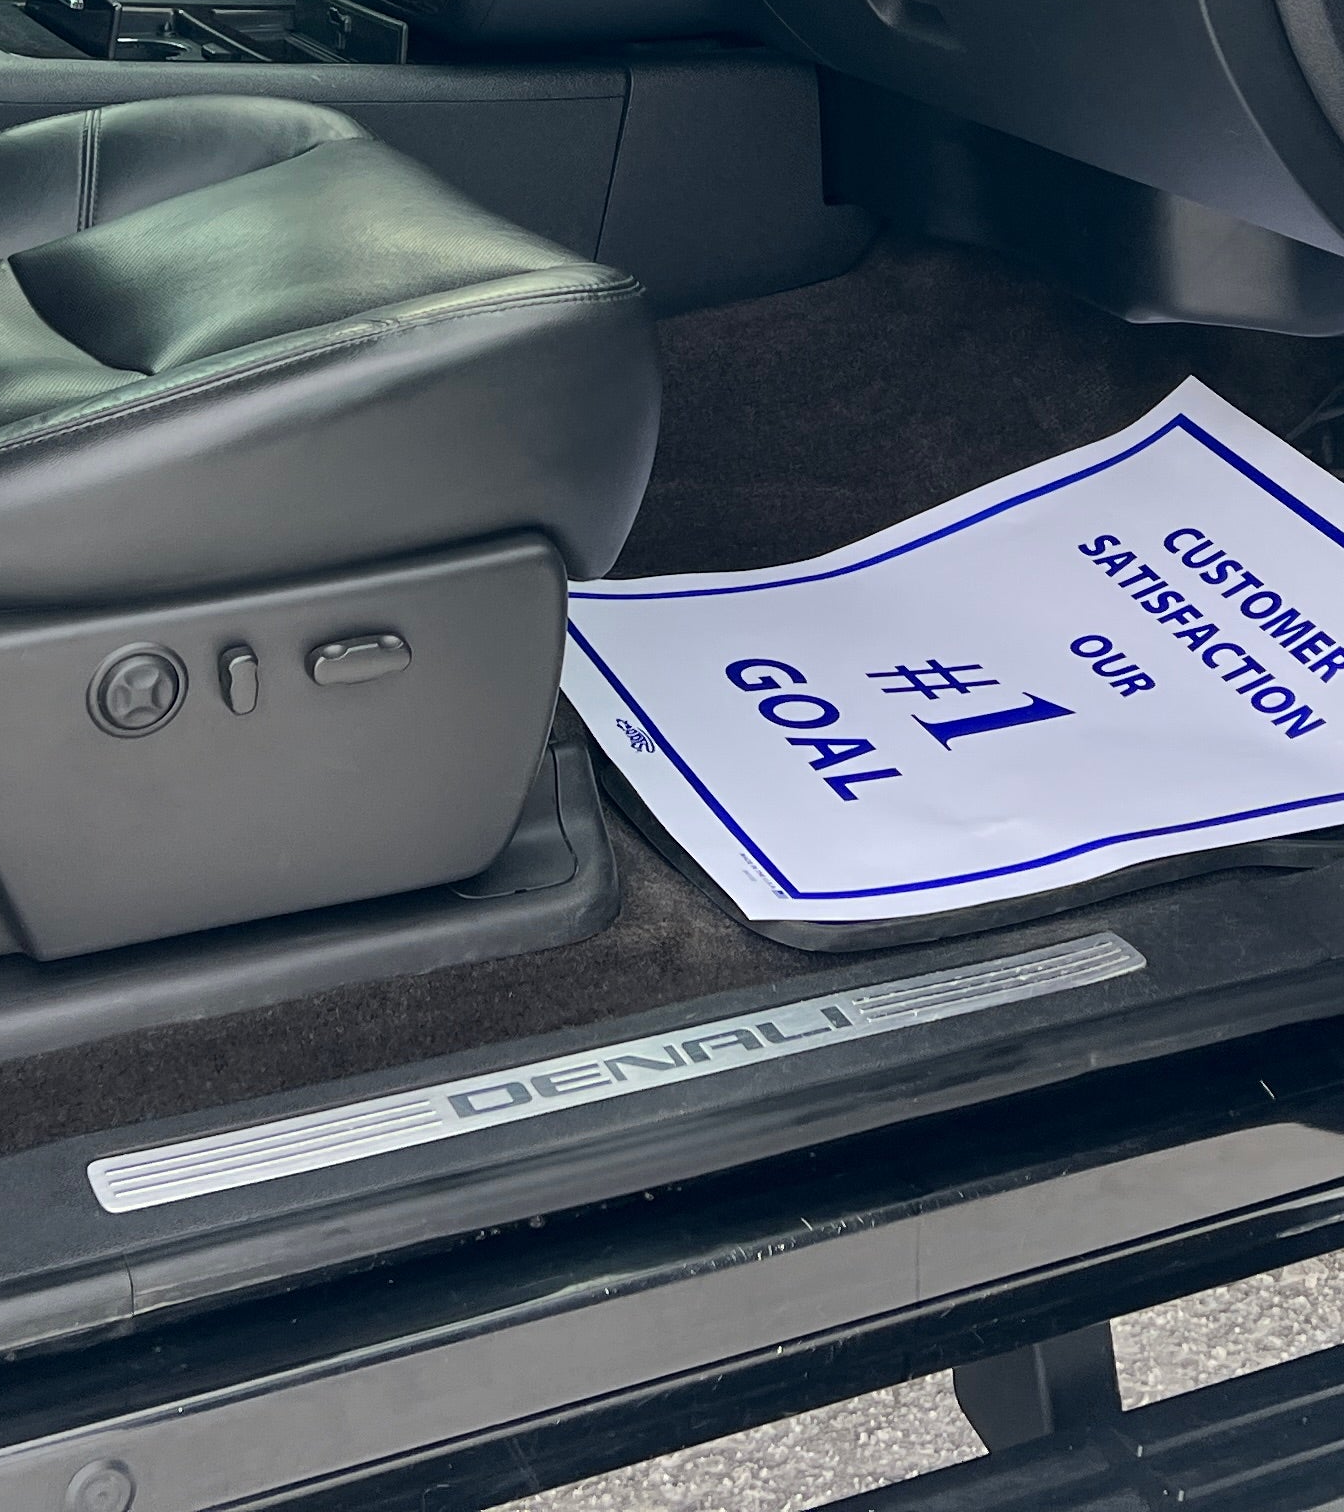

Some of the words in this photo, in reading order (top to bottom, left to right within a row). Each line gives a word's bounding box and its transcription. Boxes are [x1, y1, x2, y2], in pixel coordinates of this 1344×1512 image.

[1069, 633, 1156, 698] OUR
[1078, 533, 1326, 740] SATISFACTION
[724, 657, 903, 803] GOAL
[867, 657, 1075, 752] #1
[447, 1005, 853, 1119] DENALI
